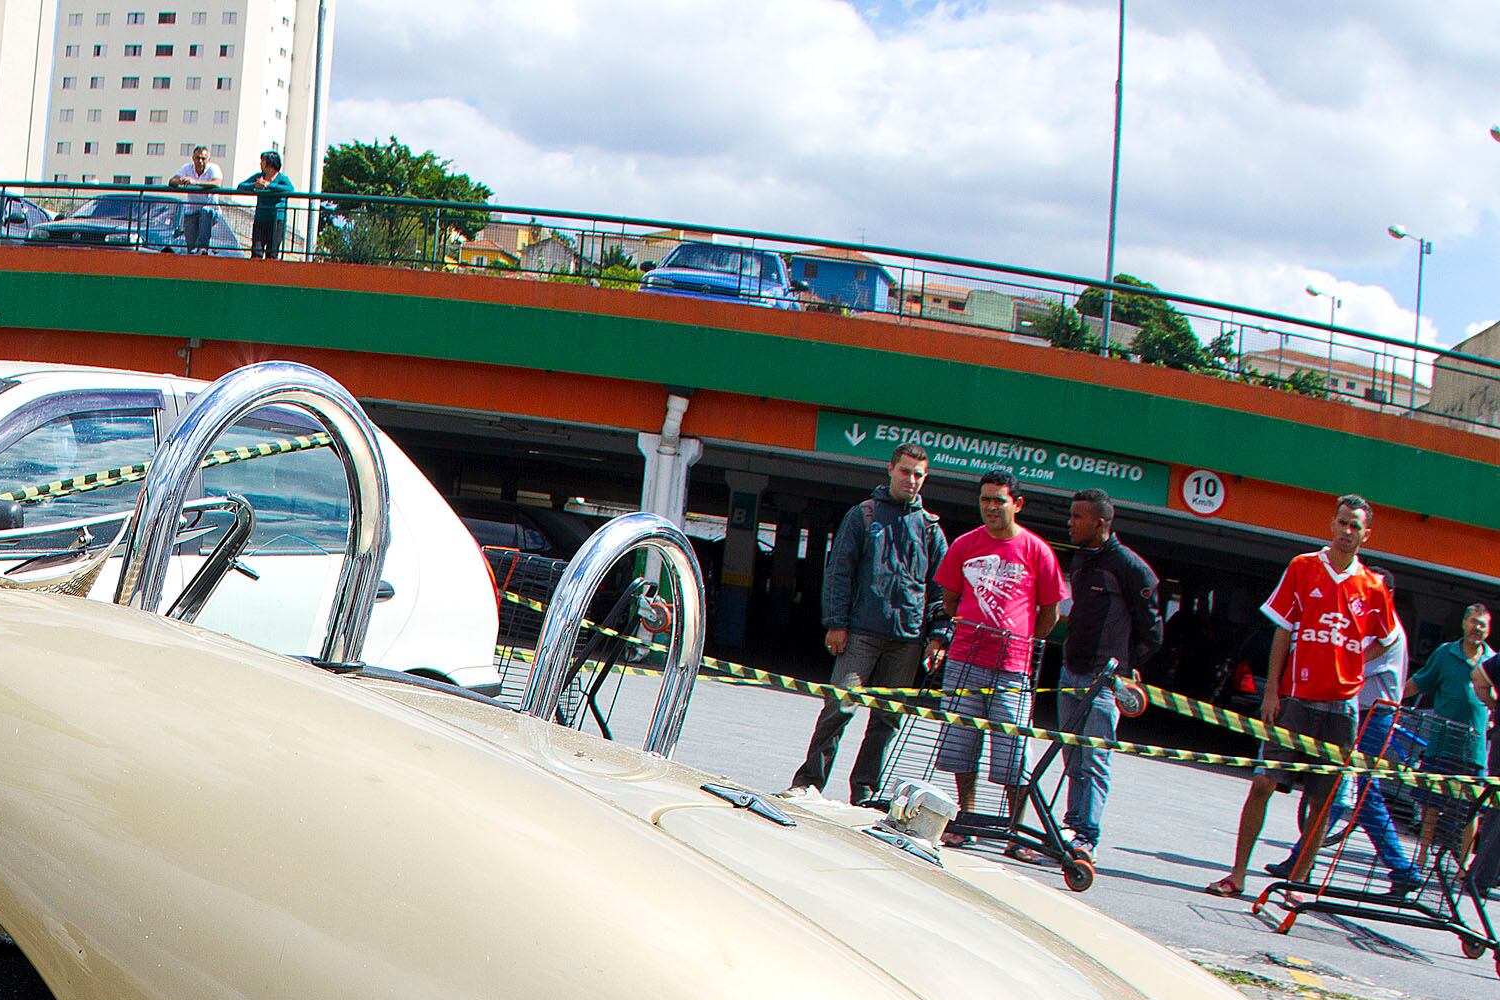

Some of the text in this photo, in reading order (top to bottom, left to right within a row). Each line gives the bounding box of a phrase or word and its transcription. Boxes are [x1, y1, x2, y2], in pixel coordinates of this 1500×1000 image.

[875, 424, 1143, 481] ESTACIONAMENTO COBERTO
[933, 452, 967, 467] Altura
[1019, 465, 1054, 481] 2,10M
[1193, 476, 1218, 497] 10
[1301, 627, 1362, 654] astra
